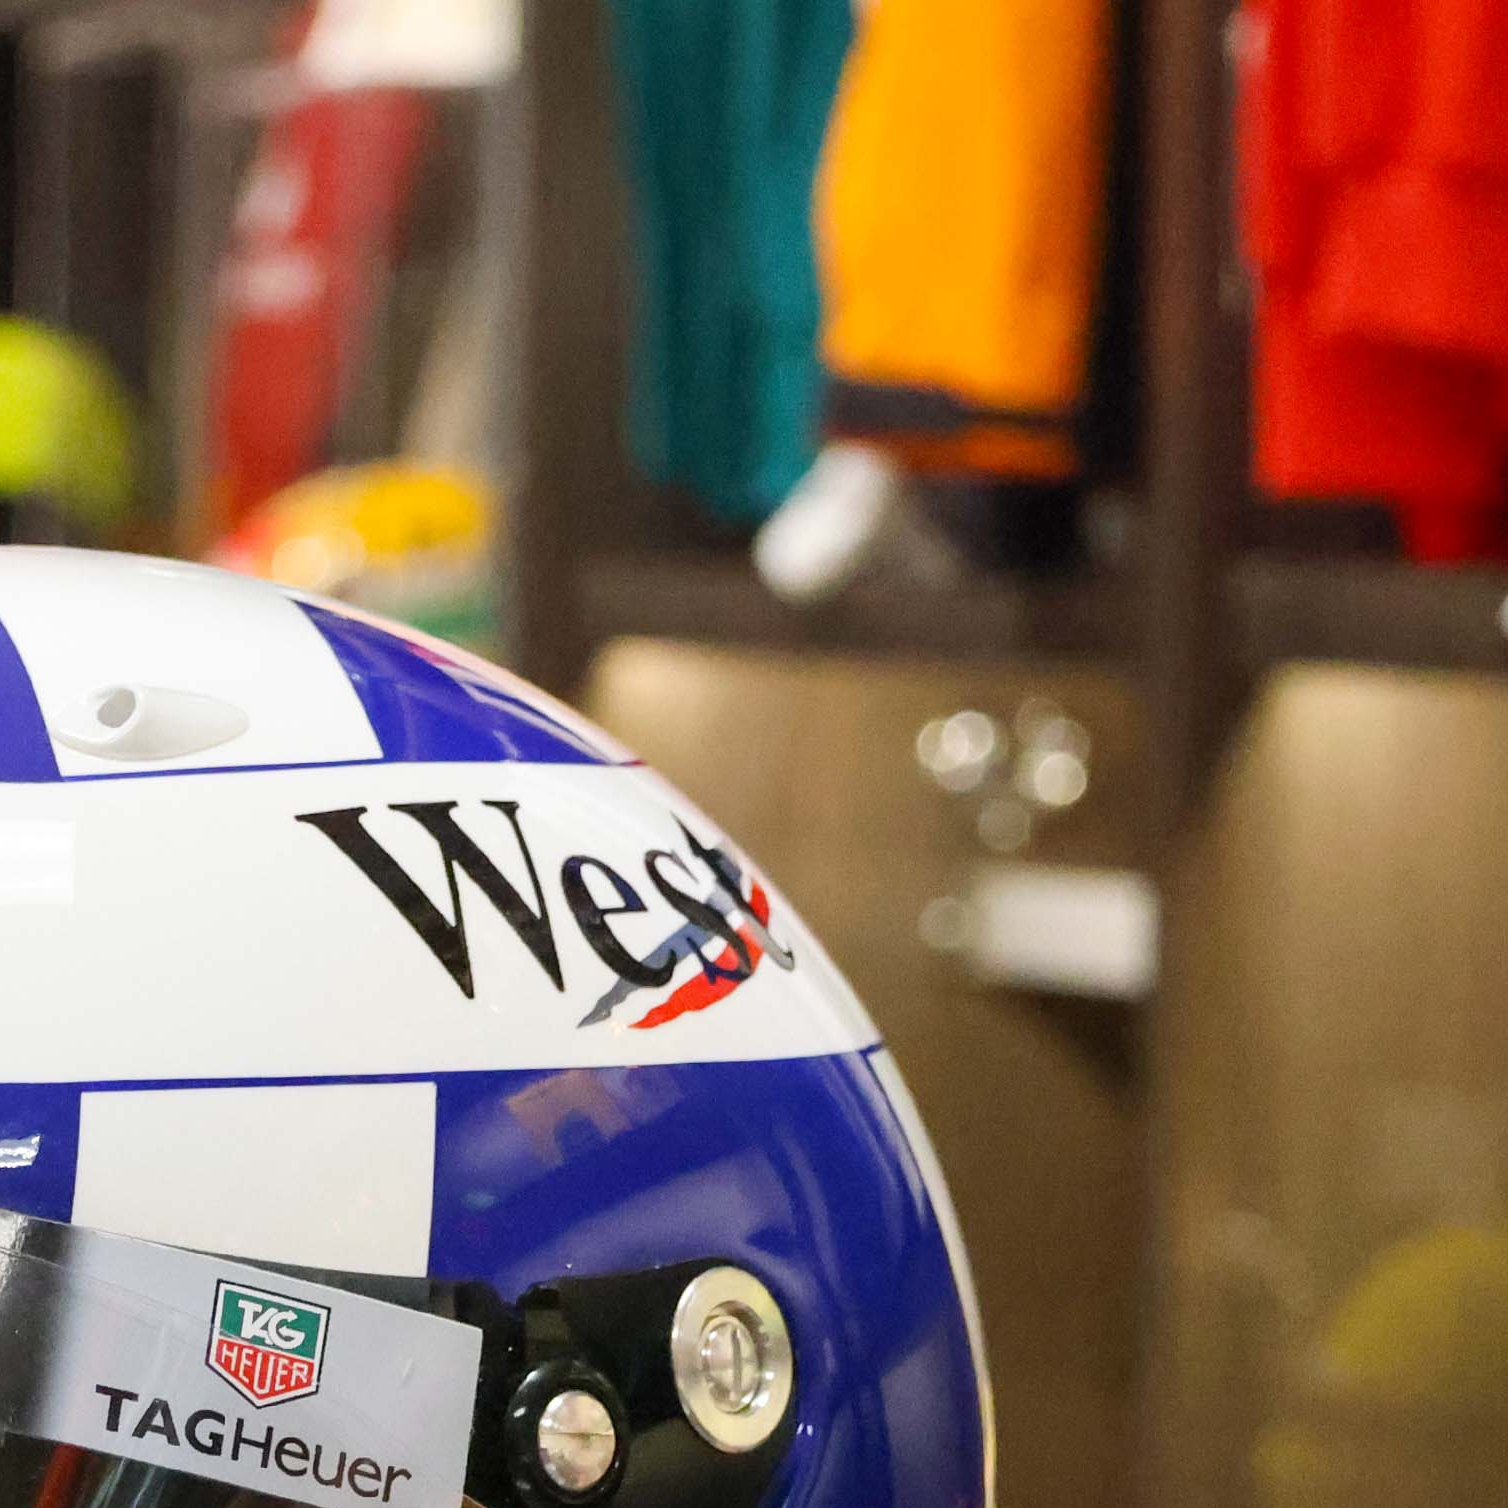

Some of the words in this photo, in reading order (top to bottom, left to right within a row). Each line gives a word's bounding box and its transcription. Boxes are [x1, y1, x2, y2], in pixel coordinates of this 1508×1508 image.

[295, 800, 794, 1000] West
[237, 1298, 306, 1350] TAG
[220, 1342, 310, 1395] HEUER
